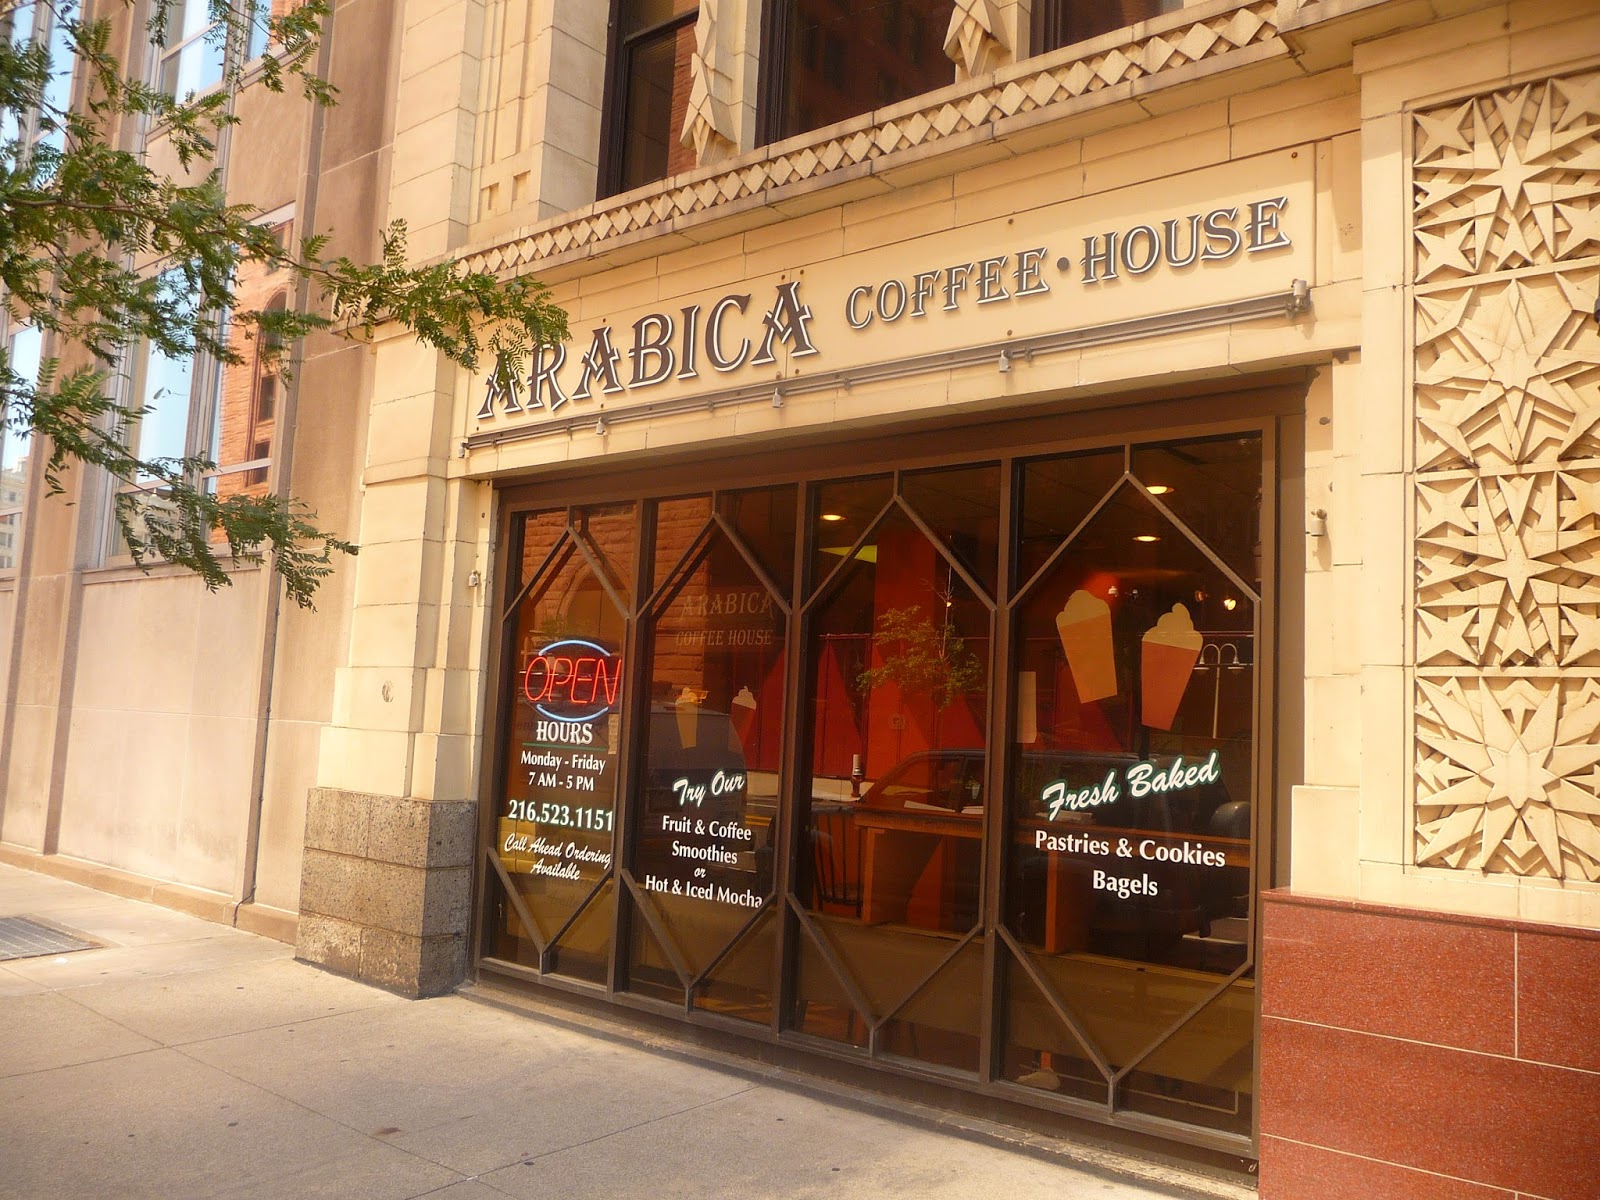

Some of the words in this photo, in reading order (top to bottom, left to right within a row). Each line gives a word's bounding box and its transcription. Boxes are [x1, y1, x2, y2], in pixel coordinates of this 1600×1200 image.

[477, 281, 819, 419] ARABICA
[845, 247, 1050, 330] COFFEE
[1080, 196, 1292, 285] HOUSE
[680, 592, 774, 619] ARABICA
[676, 630, 725, 646] COFFEE
[727, 629, 773, 645] HOUSE
[525, 656, 622, 704] OPEN
[536, 720, 593, 745] HOURS
[520, 750, 562, 772] Monday
[571, 754, 606, 775] Friday
[528, 772, 536, 785] 7
[537, 773, 557, 788] AM
[566, 775, 573, 788] 5
[576, 775, 594, 791] PM
[672, 778, 706, 807] Try
[711, 769, 745, 796] Our
[1042, 771, 1119, 822] Fresh
[1126, 752, 1219, 797] Baked
[508, 799, 614, 831] 216.523.1151
[662, 815, 691, 834] Fruit
[694, 819, 706, 835] &
[708, 820, 752, 841] Coffee
[504, 833, 527, 852] Call
[528, 835, 562, 857] Ahead
[565, 842, 611, 869] Ordering
[672, 840, 738, 864] Smoothies
[1035, 829, 1109, 856] Pastries
[1115, 837, 1133, 858] &
[1139, 839, 1226, 867] Cookies
[530, 858, 580, 881] Available
[693, 866, 707, 879] or
[645, 875, 668, 893] Hot
[671, 879, 682, 896] &
[686, 880, 713, 900] Iced
[716, 886, 763, 908] Mocha
[1092, 870, 1158, 899] Bagels
